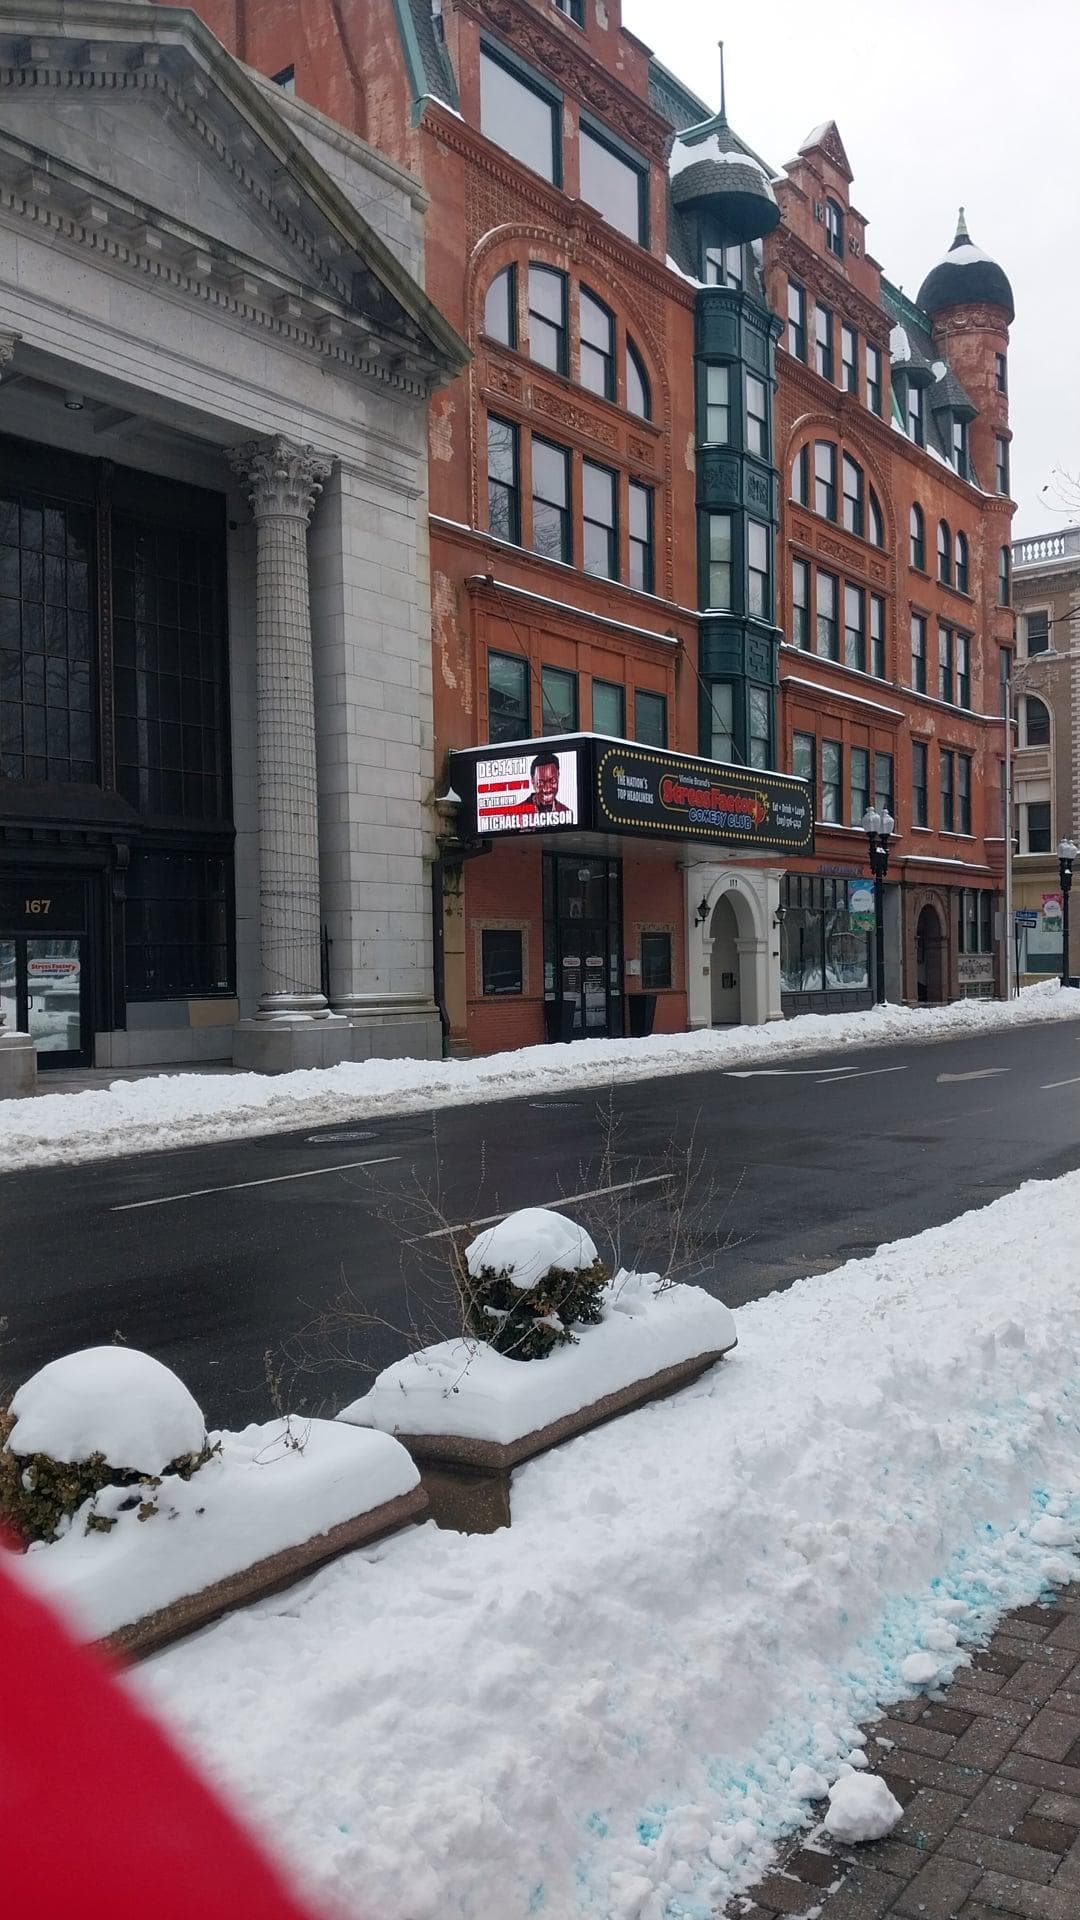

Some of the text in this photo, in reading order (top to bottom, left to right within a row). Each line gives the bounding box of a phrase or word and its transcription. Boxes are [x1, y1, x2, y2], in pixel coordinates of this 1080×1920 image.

[617, 788, 654, 805] TOP HEADLINERS
[662, 780, 763, 824] Stress Factory
[480, 811, 572, 831] MICHAEL BLACKSON
[689, 808, 752, 829] COMEDY CLUB
[25, 900, 51, 914] 167
